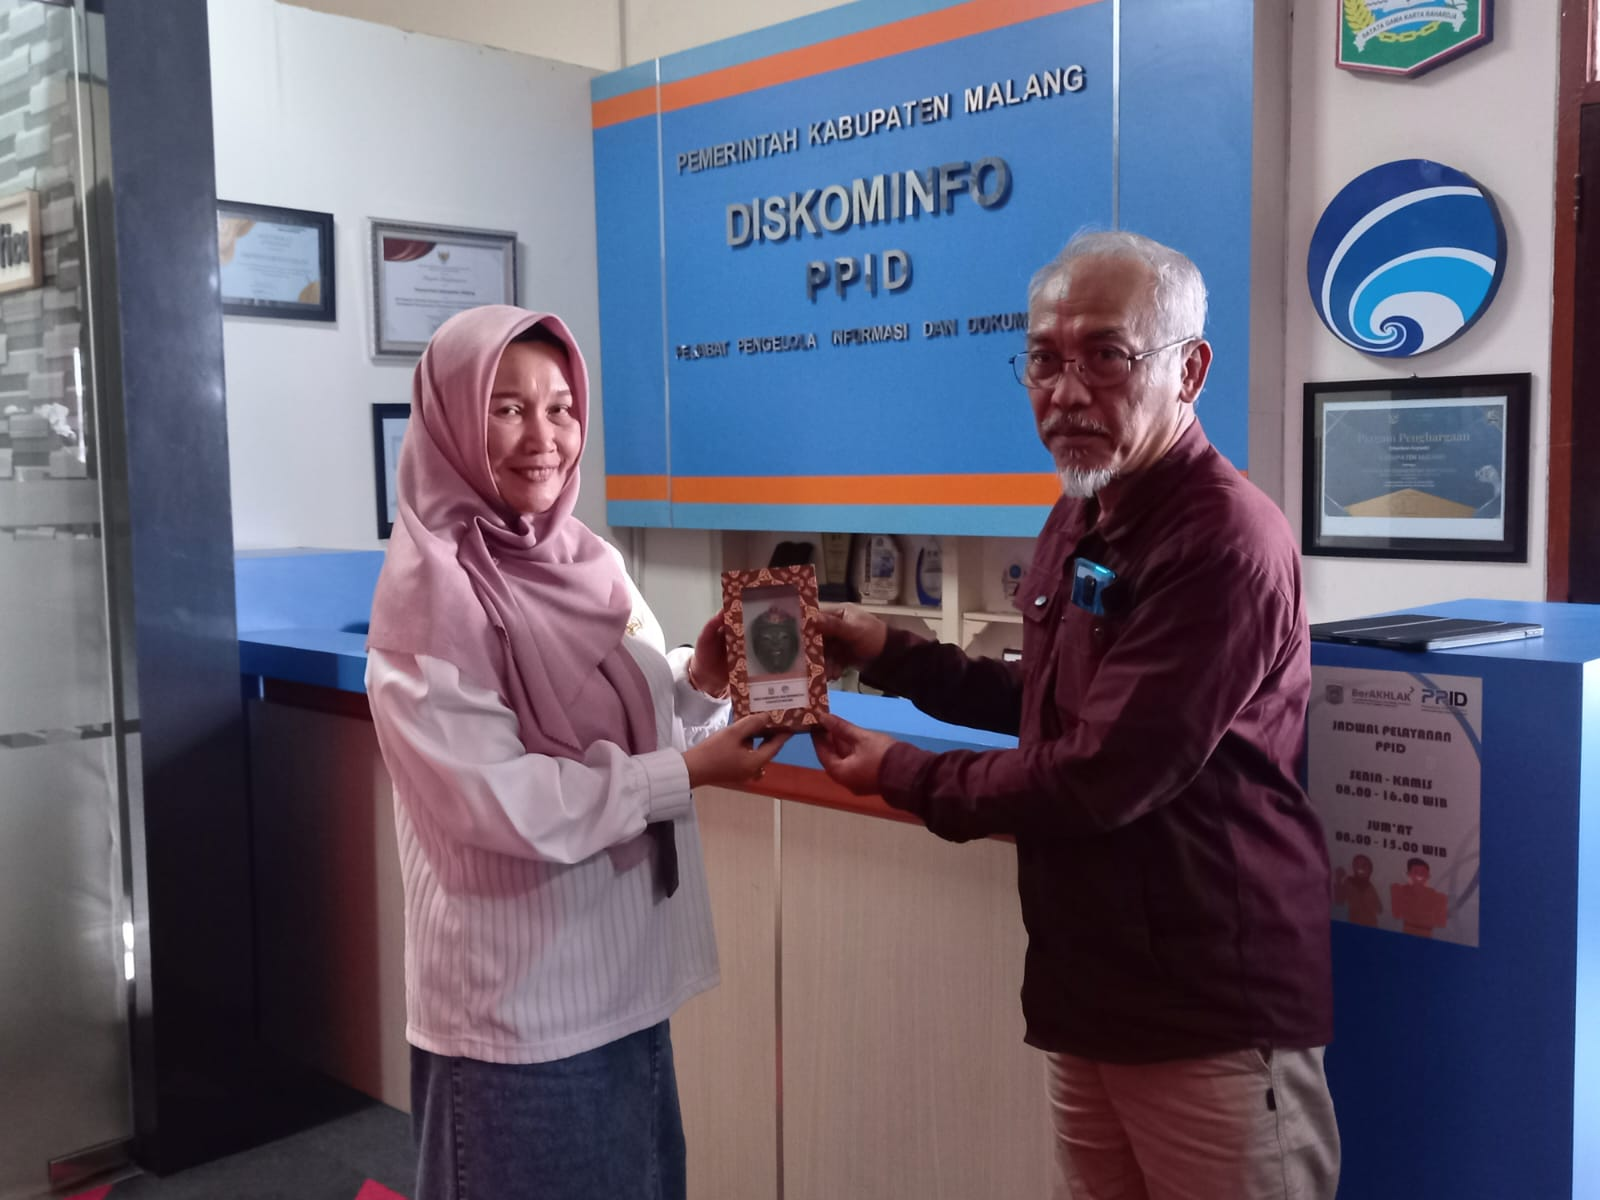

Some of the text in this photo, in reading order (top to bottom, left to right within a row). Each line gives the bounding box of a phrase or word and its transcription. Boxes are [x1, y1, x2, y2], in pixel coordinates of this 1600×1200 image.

[677, 64, 1087, 175] PEMERINTAH KABUPATEN MALANG
[725, 156, 1013, 249] DISKOMINFO
[806, 249, 912, 301] PPID
[738, 333, 818, 356] PENGELOLA
[922, 318, 959, 341] DAN
[1351, 687, 1411, 702] BerAKHLAK
[1421, 688, 1468, 707] PPID
[1333, 720, 1452, 743] JADWAL PELAYANAN
[1375, 741, 1406, 754] PPID
[1350, 769, 1383, 783] SENIN
[1392, 775, 1433, 790] KAMIS
[1335, 783, 1372, 798] 08.00
[1383, 790, 1419, 805] 16.00
[1422, 795, 1448, 809] WIB
[1367, 820, 1413, 836] JUM'AT
[1335, 831, 1372, 846] 08.00
[1383, 838, 1419, 853] 15.00
[1422, 844, 1448, 858] WIB
